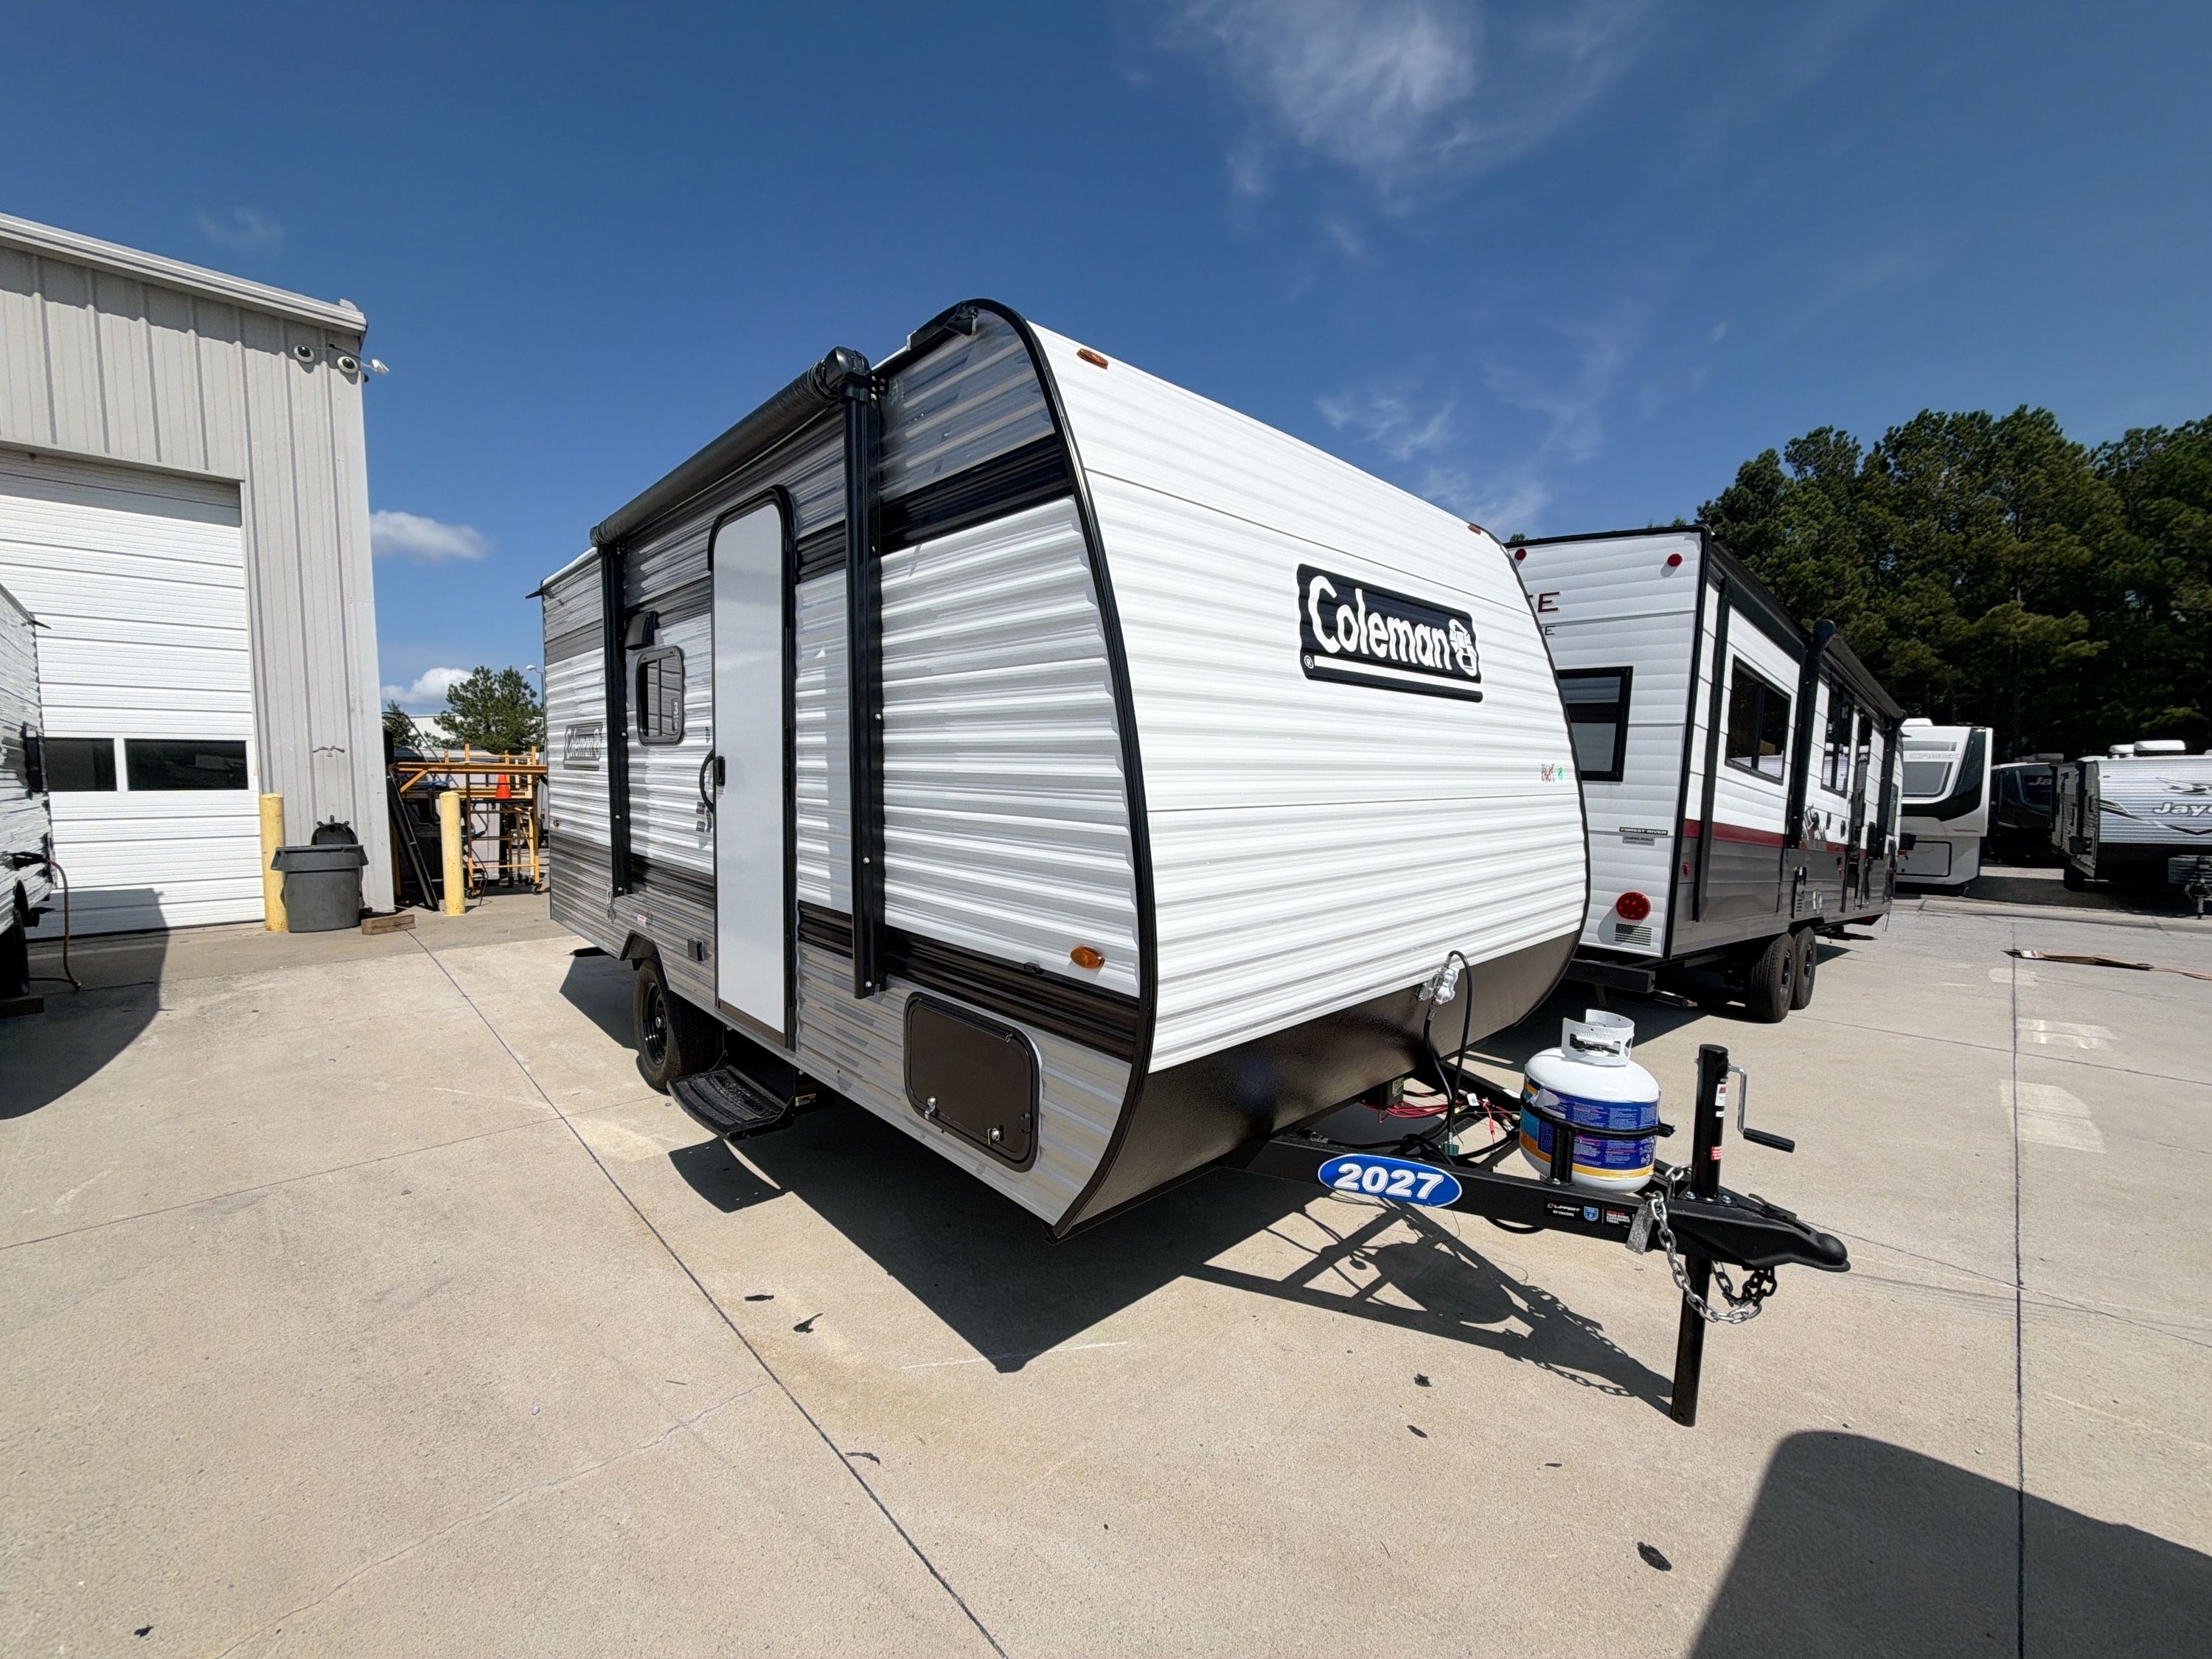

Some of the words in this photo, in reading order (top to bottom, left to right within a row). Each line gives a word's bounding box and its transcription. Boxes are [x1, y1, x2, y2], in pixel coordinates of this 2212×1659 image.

[1308, 575, 1453, 670] Coleman
[566, 727, 595, 760] Coleman
[2152, 801, 2212, 817] Jay
[1333, 1163, 1444, 1200] 2027
